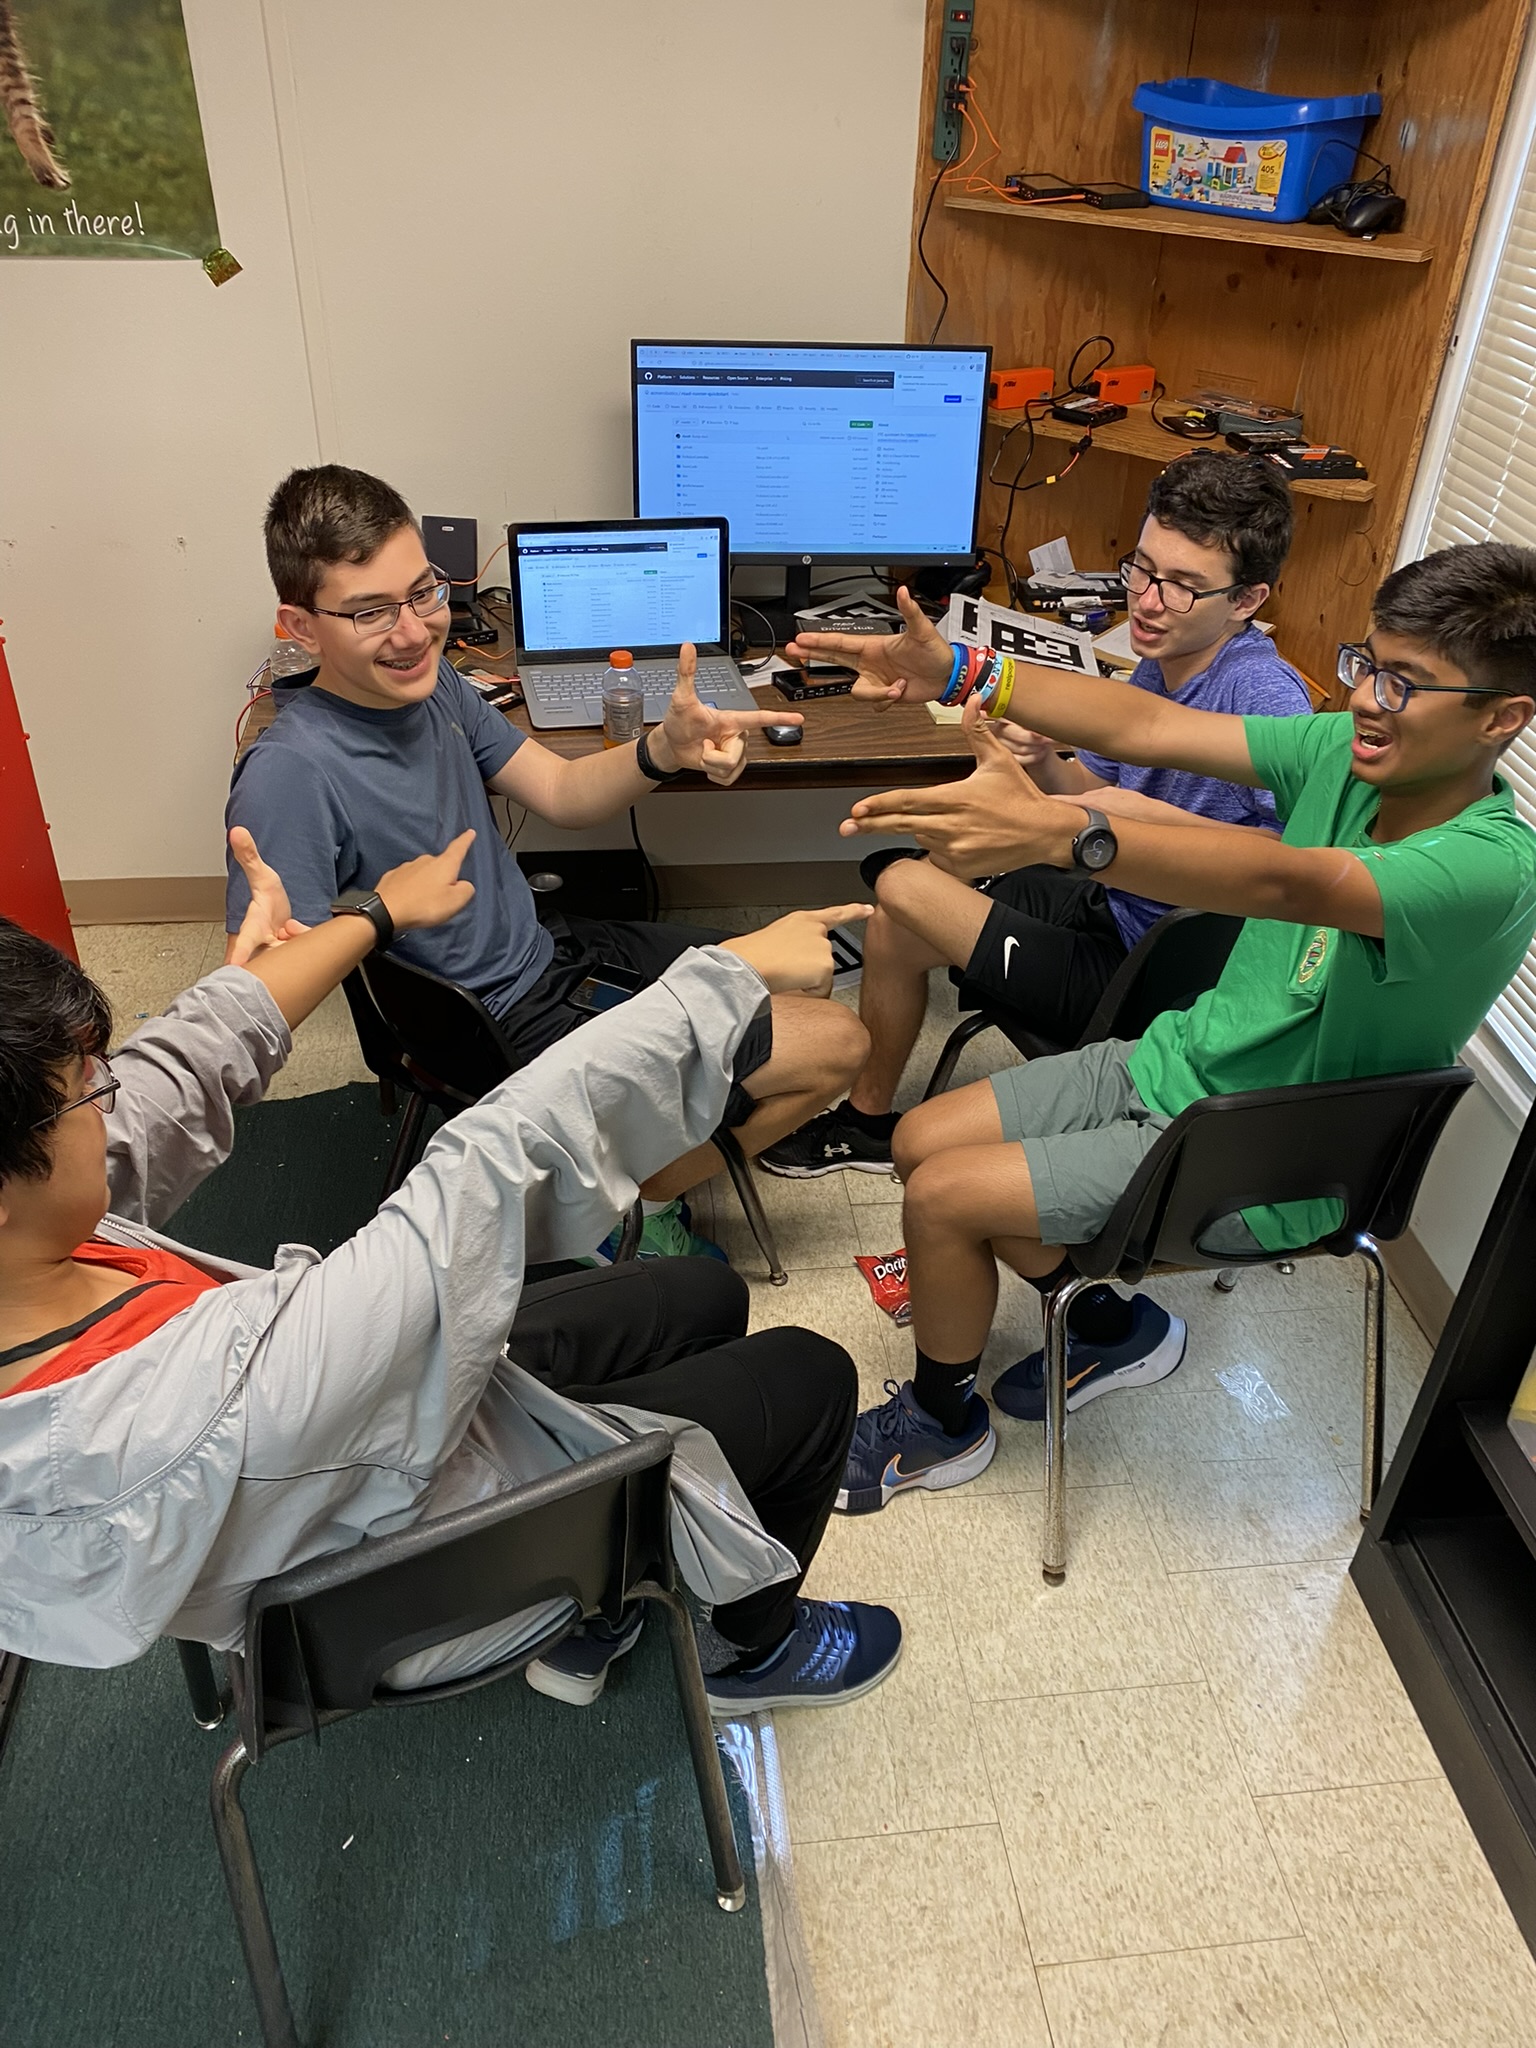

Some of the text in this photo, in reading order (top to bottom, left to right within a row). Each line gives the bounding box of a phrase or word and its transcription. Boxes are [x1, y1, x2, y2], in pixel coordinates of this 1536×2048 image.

[1155, 140, 1168, 150] LEGO
[1261, 165, 1275, 174] 405
[0, 199, 145, 249] g in there!
[993, 658, 1003, 676] NY
[949, 665, 968, 699] NYPD
[873, 1257, 907, 1280] Dorit
